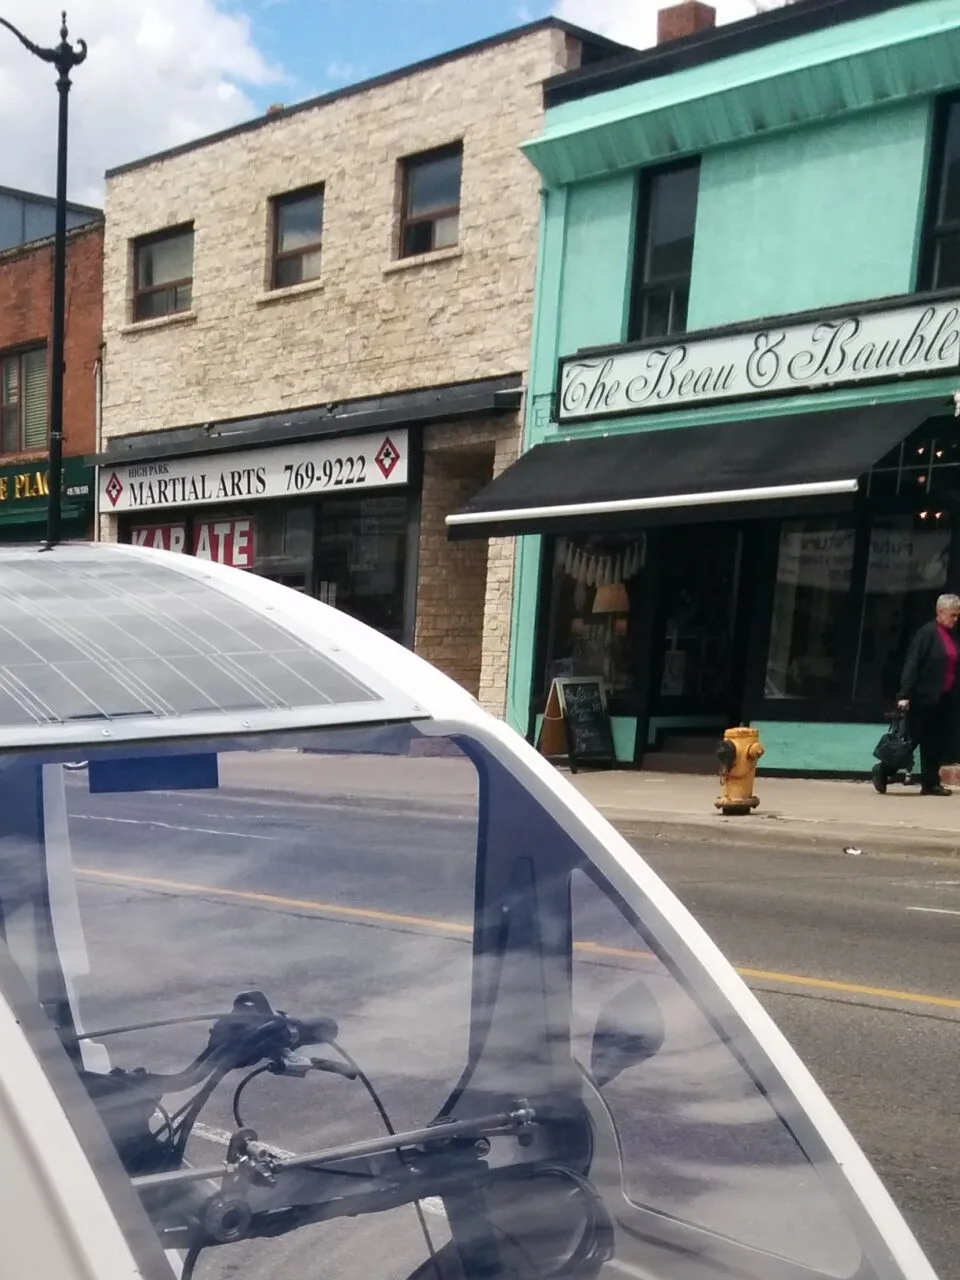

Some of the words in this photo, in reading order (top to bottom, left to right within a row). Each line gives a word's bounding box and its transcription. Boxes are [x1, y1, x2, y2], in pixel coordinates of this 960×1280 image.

[562, 357, 620, 412] The
[624, 345, 737, 404] Beau
[744, 332, 786, 389] &
[128, 466, 148, 479] HIGH
[148, 463, 170, 476] PARK
[128, 474, 213, 507] MARTIAL
[216, 467, 267, 498] ARTS
[283, 454, 367, 491] 769-9222
